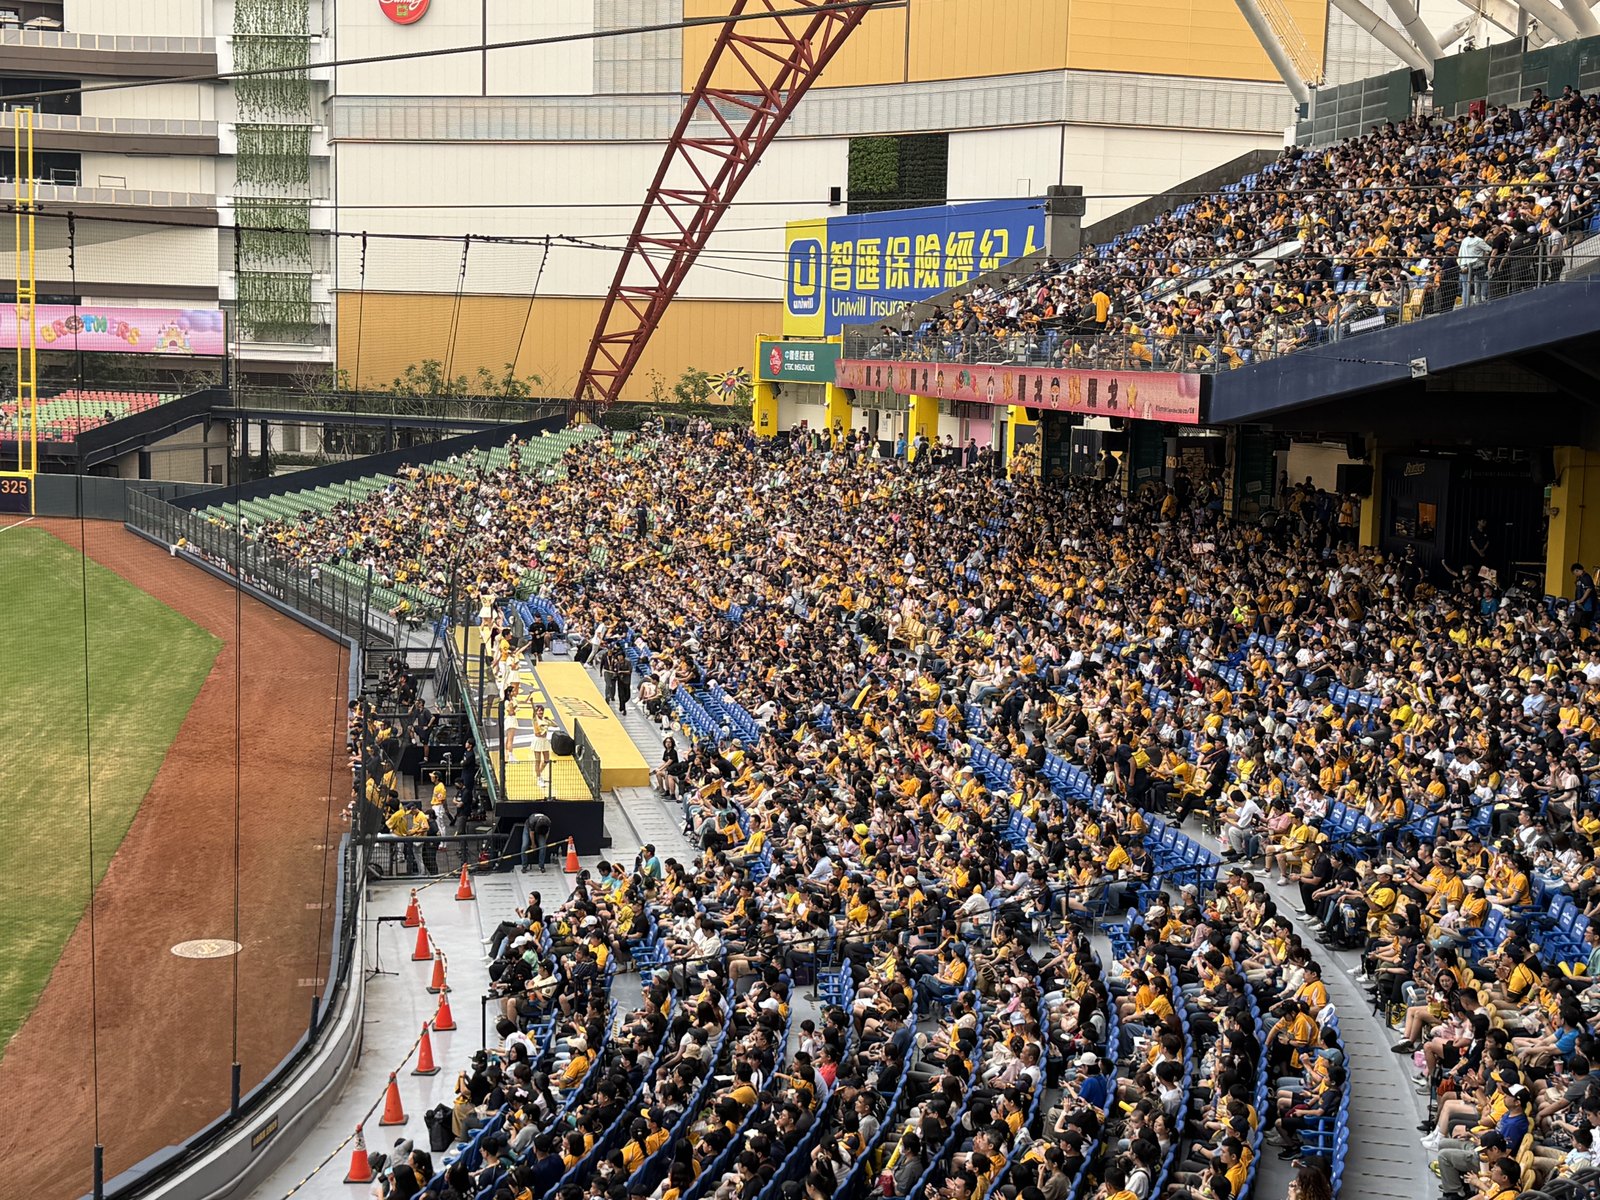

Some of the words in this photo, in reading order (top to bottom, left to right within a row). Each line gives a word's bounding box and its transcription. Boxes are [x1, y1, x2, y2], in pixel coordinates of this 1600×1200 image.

[831, 296, 866, 317] Uniwill
[870, 297, 918, 317] Insura
[41, 314, 141, 346] BROTHERS
[1, 480, 28, 494] 325
